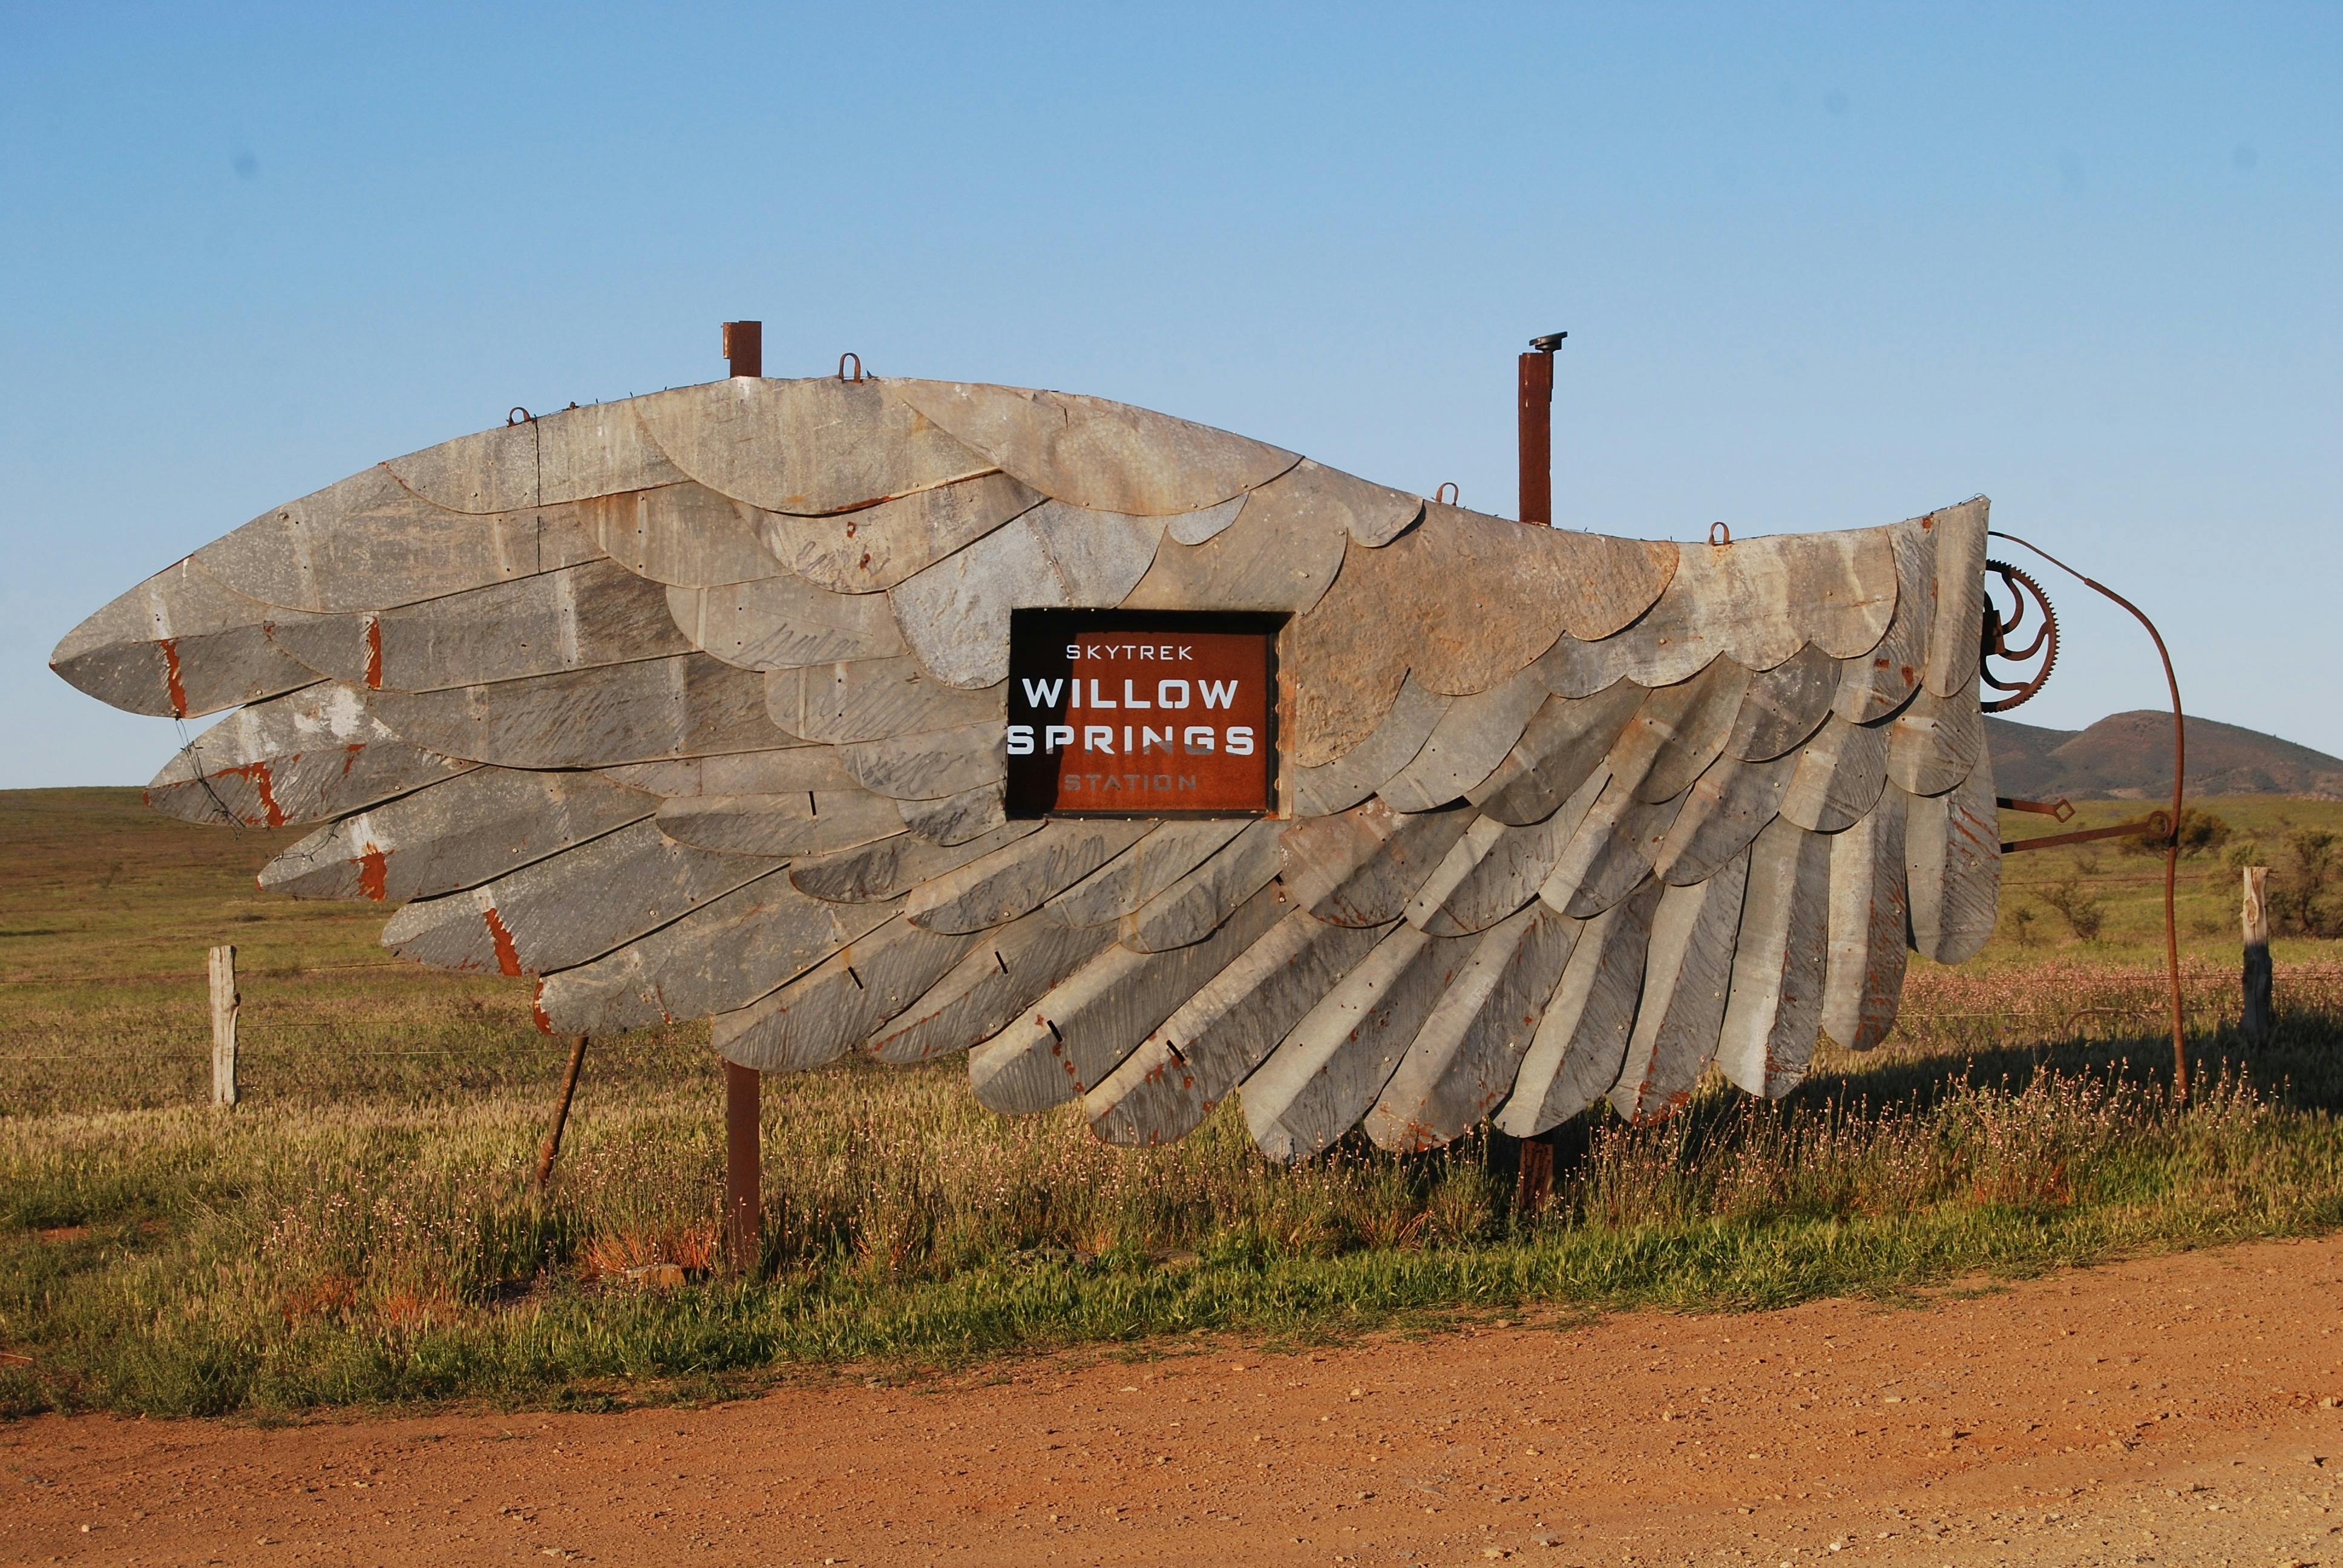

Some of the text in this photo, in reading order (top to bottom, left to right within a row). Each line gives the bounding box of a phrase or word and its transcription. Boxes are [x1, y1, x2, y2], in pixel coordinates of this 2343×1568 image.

[1066, 644, 1193, 661] SKYTREK
[1022, 678, 1238, 709] WILLOW
[1007, 725, 1254, 756] SPRINGS
[1064, 774, 1196, 792] STATION
